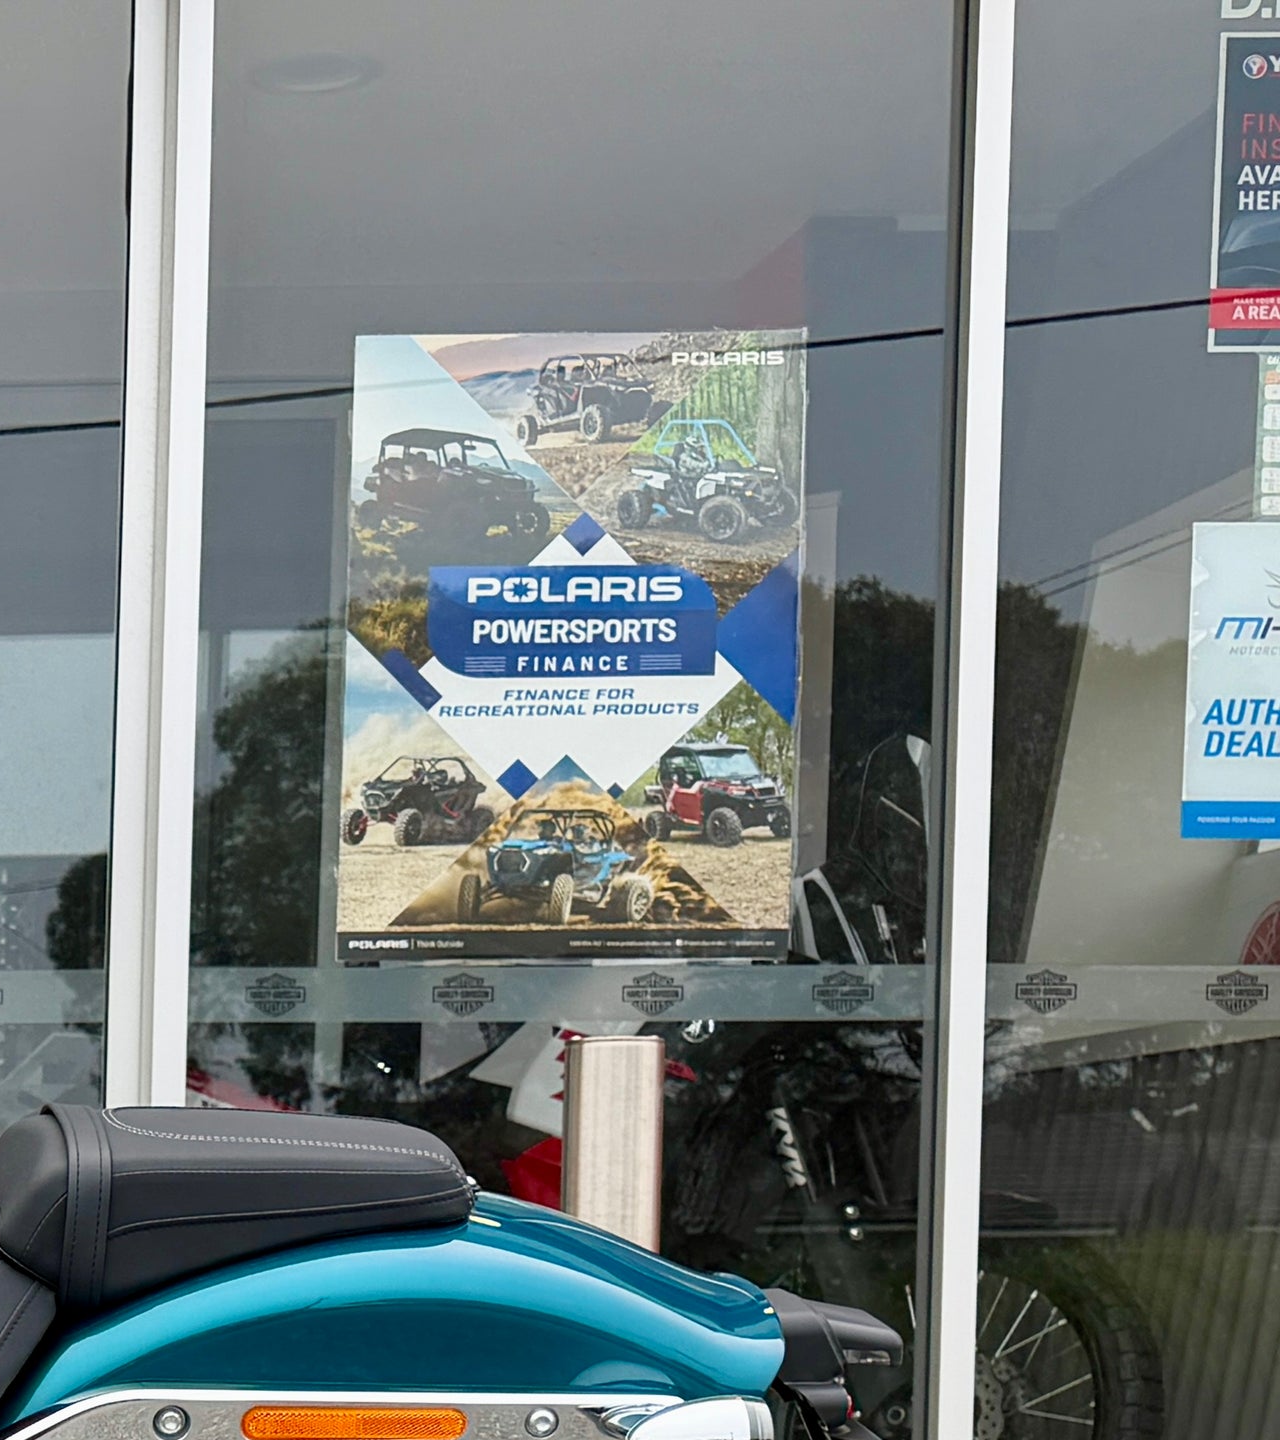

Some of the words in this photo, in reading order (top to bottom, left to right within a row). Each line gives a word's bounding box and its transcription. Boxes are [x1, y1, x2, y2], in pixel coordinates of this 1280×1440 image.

[671, 350, 785, 367] POLARIS
[467, 576, 683, 604] POLARIS
[472, 618, 677, 644] POWERSPORTS
[517, 655, 629, 672] FINANCE
[503, 688, 591, 701] FINANCE
[595, 688, 636, 700] FOR
[439, 704, 588, 718] RECREATIONAL
[592, 703, 700, 716] PRODUCTS
[348, 939, 410, 950] POLARIS
